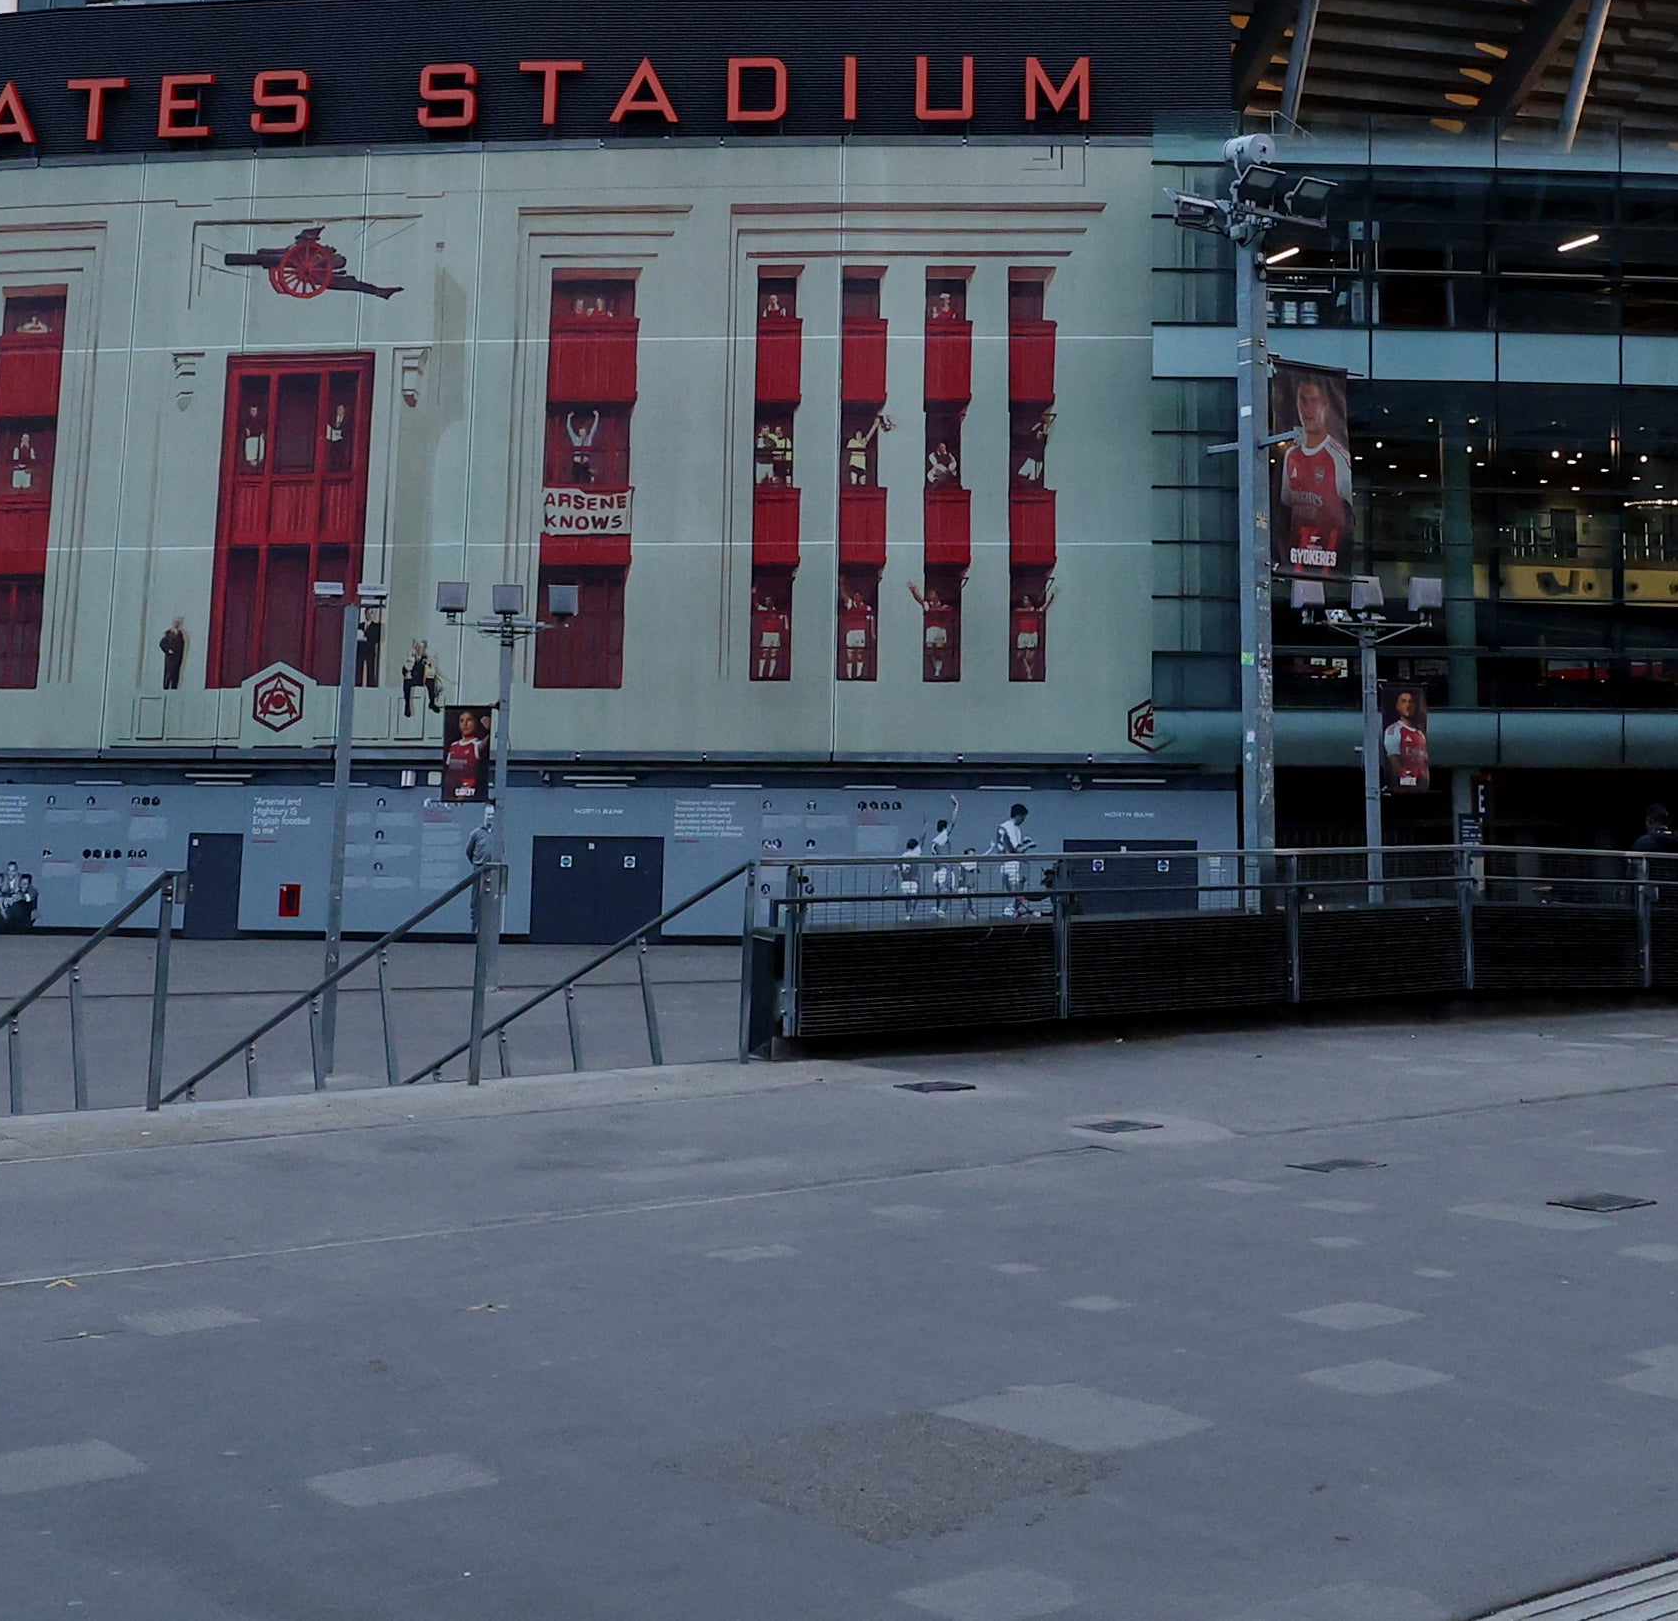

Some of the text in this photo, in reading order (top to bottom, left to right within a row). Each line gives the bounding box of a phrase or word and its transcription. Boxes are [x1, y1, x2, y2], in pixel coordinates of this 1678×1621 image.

[416, 56, 1092, 129] STADIUM
[543, 492, 627, 511] ARSENE
[544, 513, 623, 530] KNOWS
